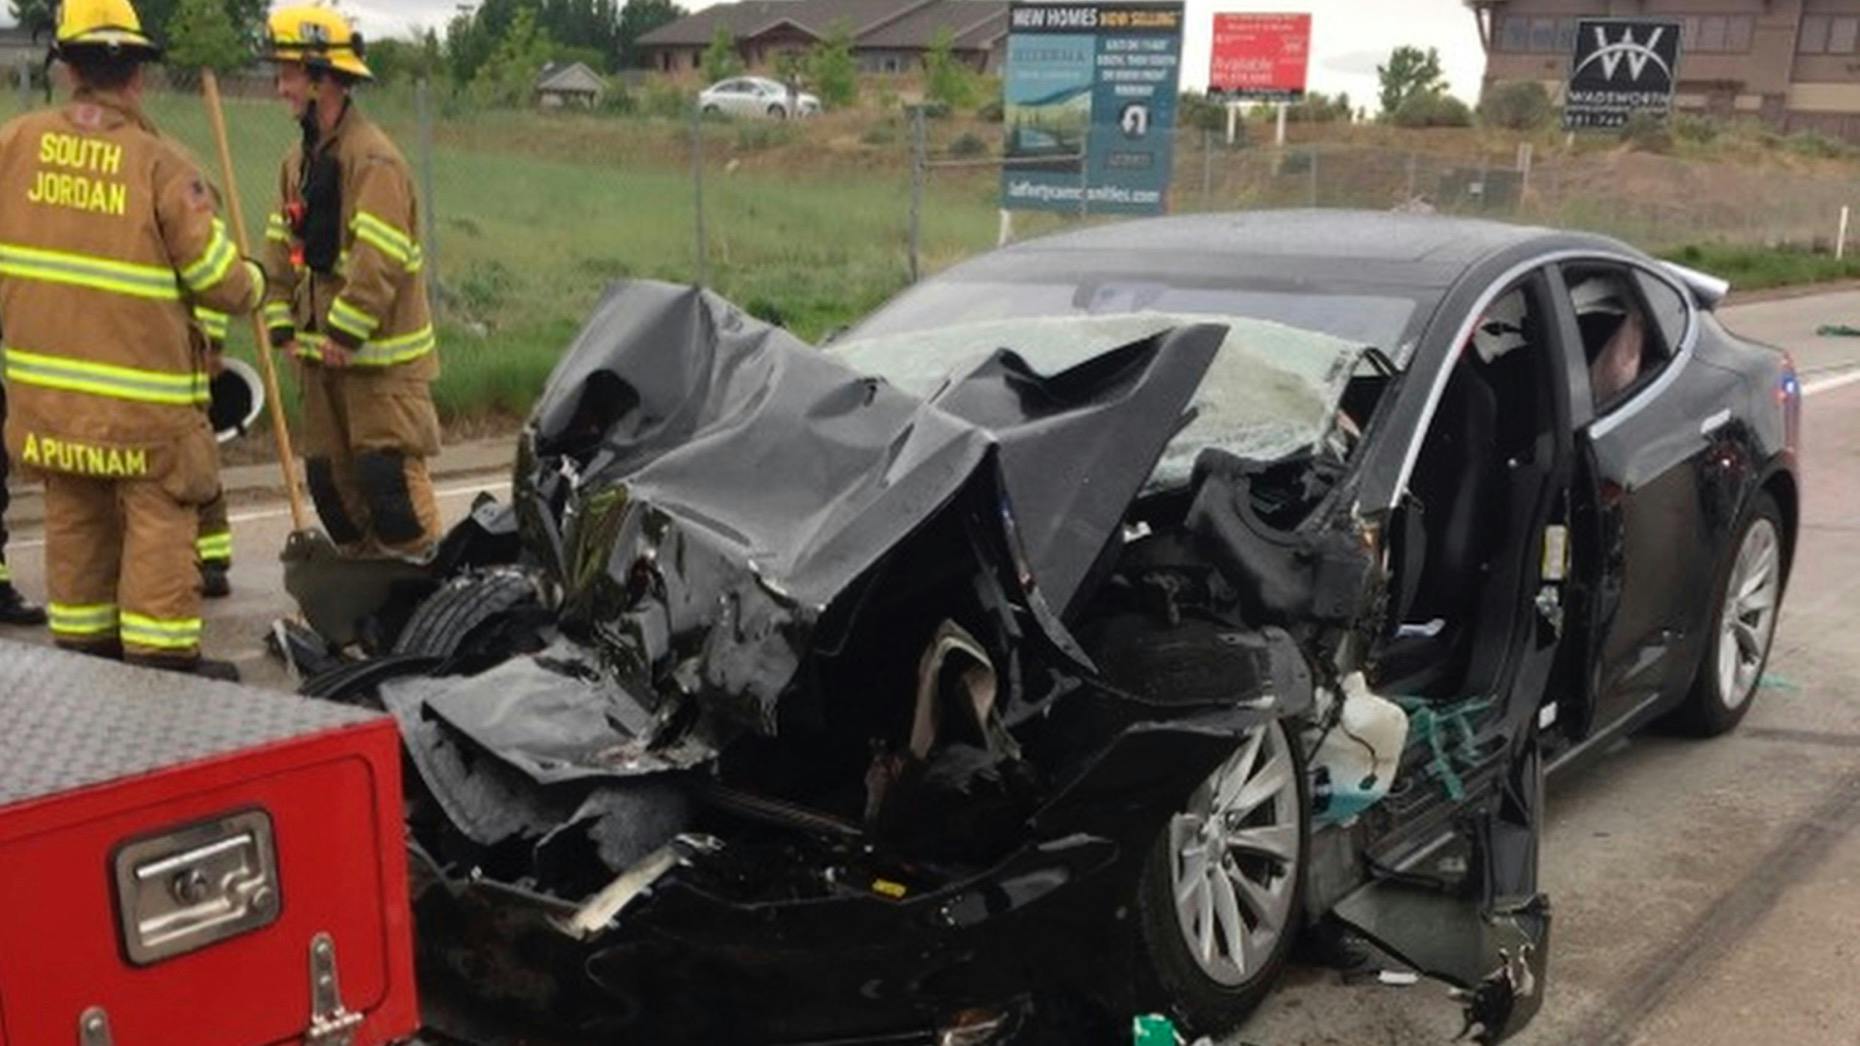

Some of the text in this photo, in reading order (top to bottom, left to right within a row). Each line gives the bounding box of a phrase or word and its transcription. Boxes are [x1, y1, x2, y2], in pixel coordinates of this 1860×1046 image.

[1012, 8, 1045, 27] NEW
[1047, 8, 1098, 27] HOMES
[1567, 91, 1669, 104] WADSWORTH
[40, 132, 121, 175] SOUTH
[28, 172, 126, 215] JORDAN
